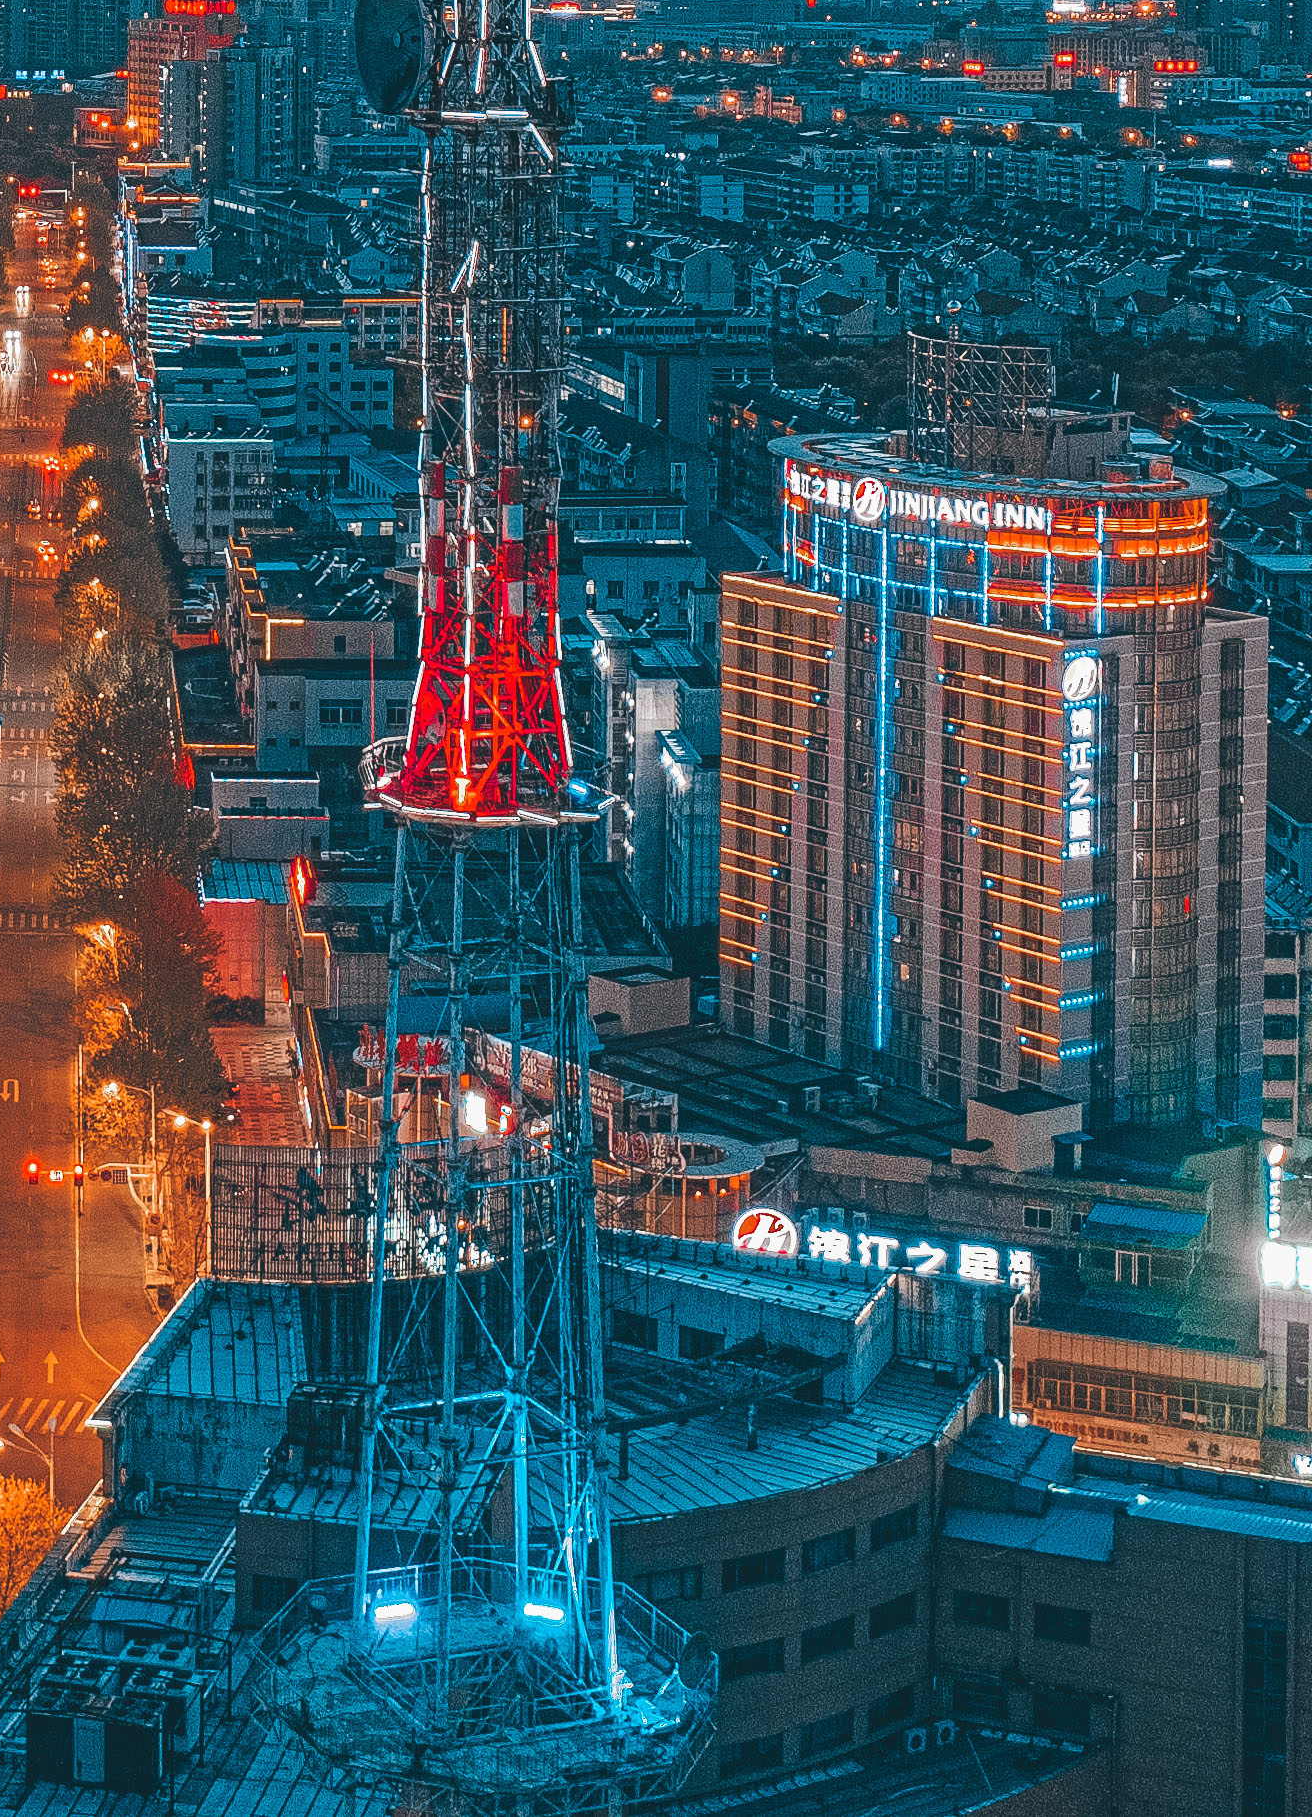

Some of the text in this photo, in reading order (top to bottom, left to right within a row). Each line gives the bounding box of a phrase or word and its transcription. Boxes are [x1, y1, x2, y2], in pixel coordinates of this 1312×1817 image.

[890, 489, 1046, 531] JINJIANG INN
[808, 1226, 1001, 1283] 锦江之星
